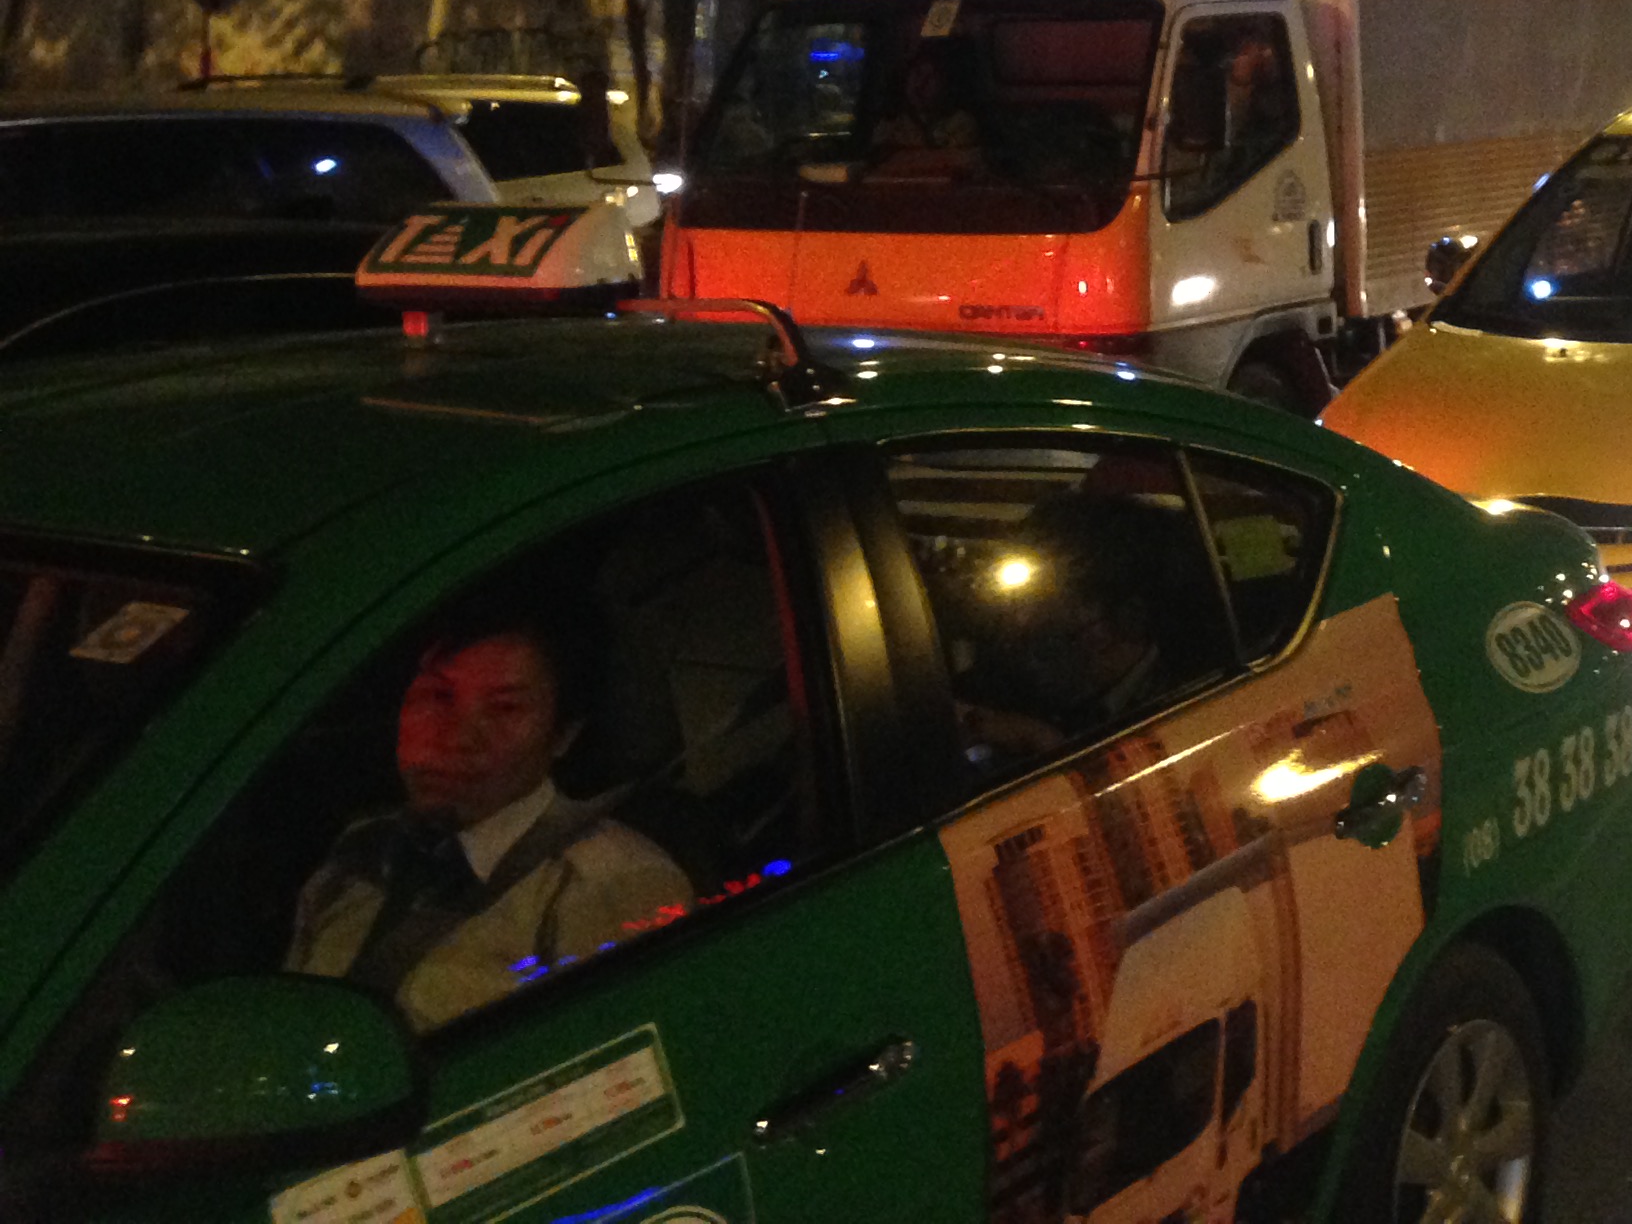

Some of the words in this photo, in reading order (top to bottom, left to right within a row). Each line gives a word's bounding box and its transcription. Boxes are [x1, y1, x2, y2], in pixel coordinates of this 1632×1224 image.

[1494, 614, 1573, 678] 8340
[1513, 747, 1551, 837] 38
[1559, 725, 1596, 813] 38
